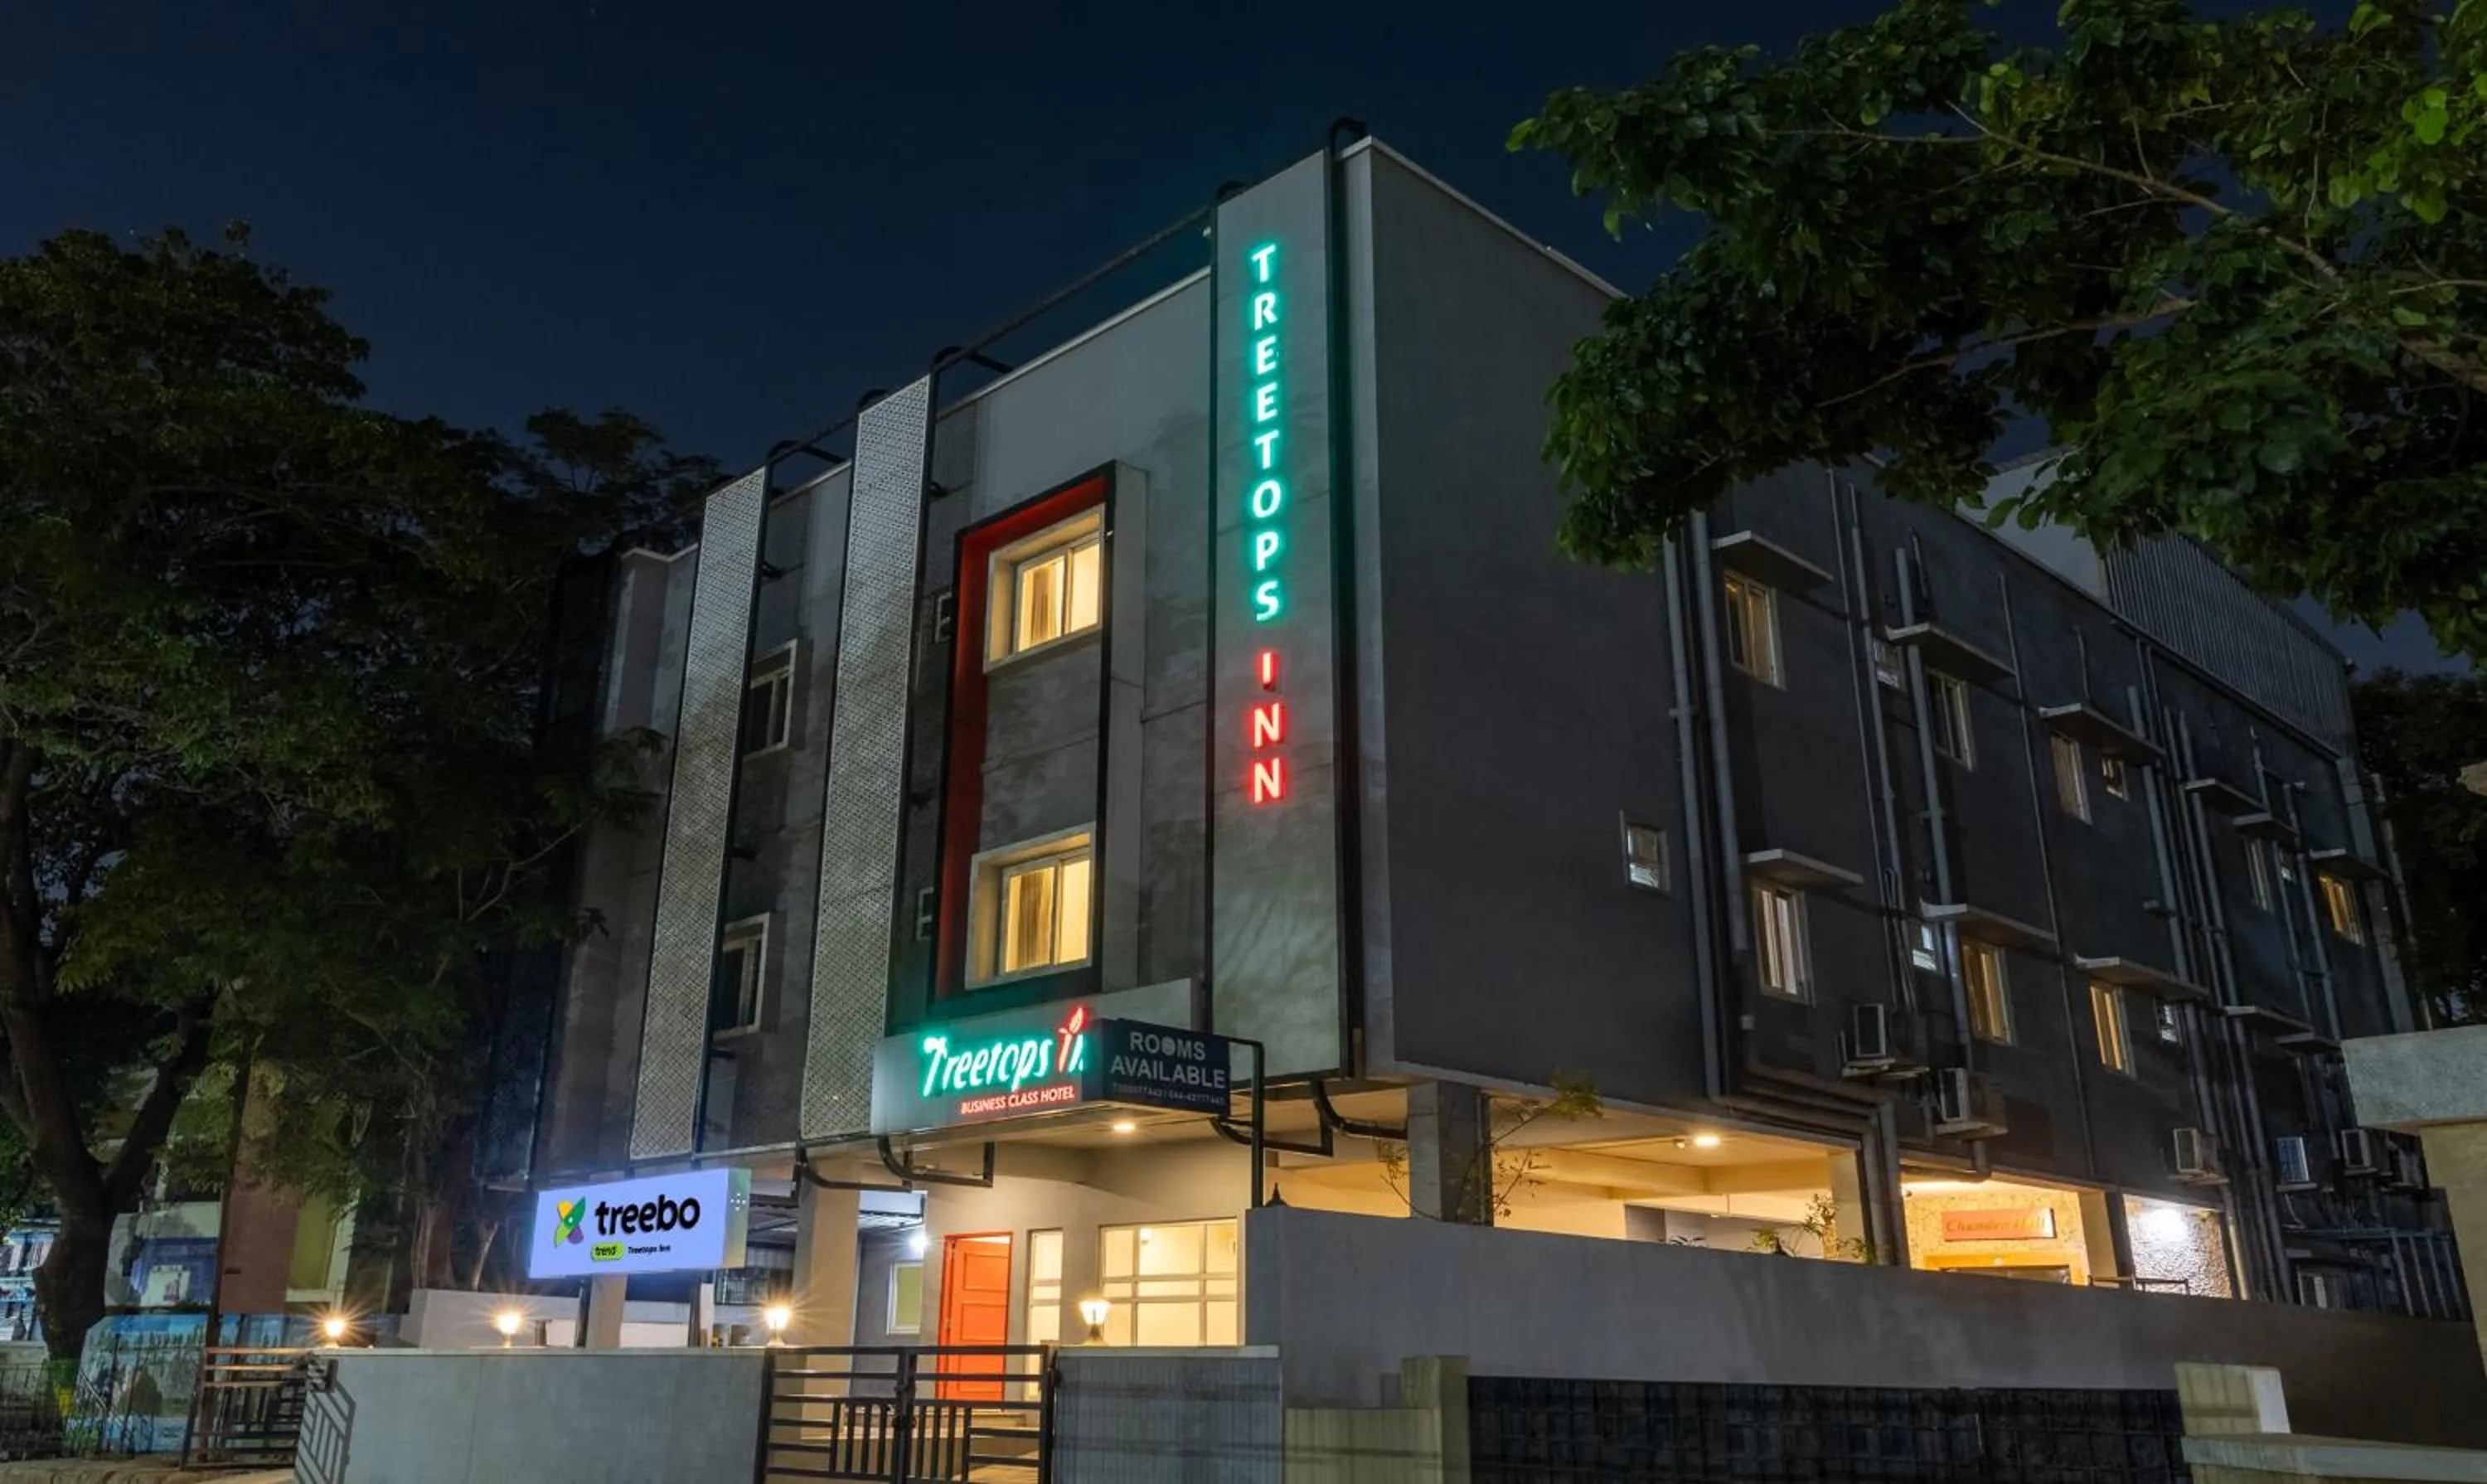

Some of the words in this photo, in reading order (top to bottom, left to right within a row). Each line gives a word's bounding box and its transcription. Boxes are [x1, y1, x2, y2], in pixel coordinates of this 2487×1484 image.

[1251, 244, 1281, 622] TREETOPS
[1253, 652, 1281, 803] INN
[923, 1036, 1053, 1097] Treetops
[1129, 1031, 1206, 1061] ROOMS
[1109, 1055, 1226, 1089] AVAILABLE
[961, 1095, 1006, 1114] BUSINESS
[1007, 1090, 1040, 1108] CLASS
[1040, 1085, 1075, 1102] HOTEL
[594, 1194, 701, 1235] treebo
